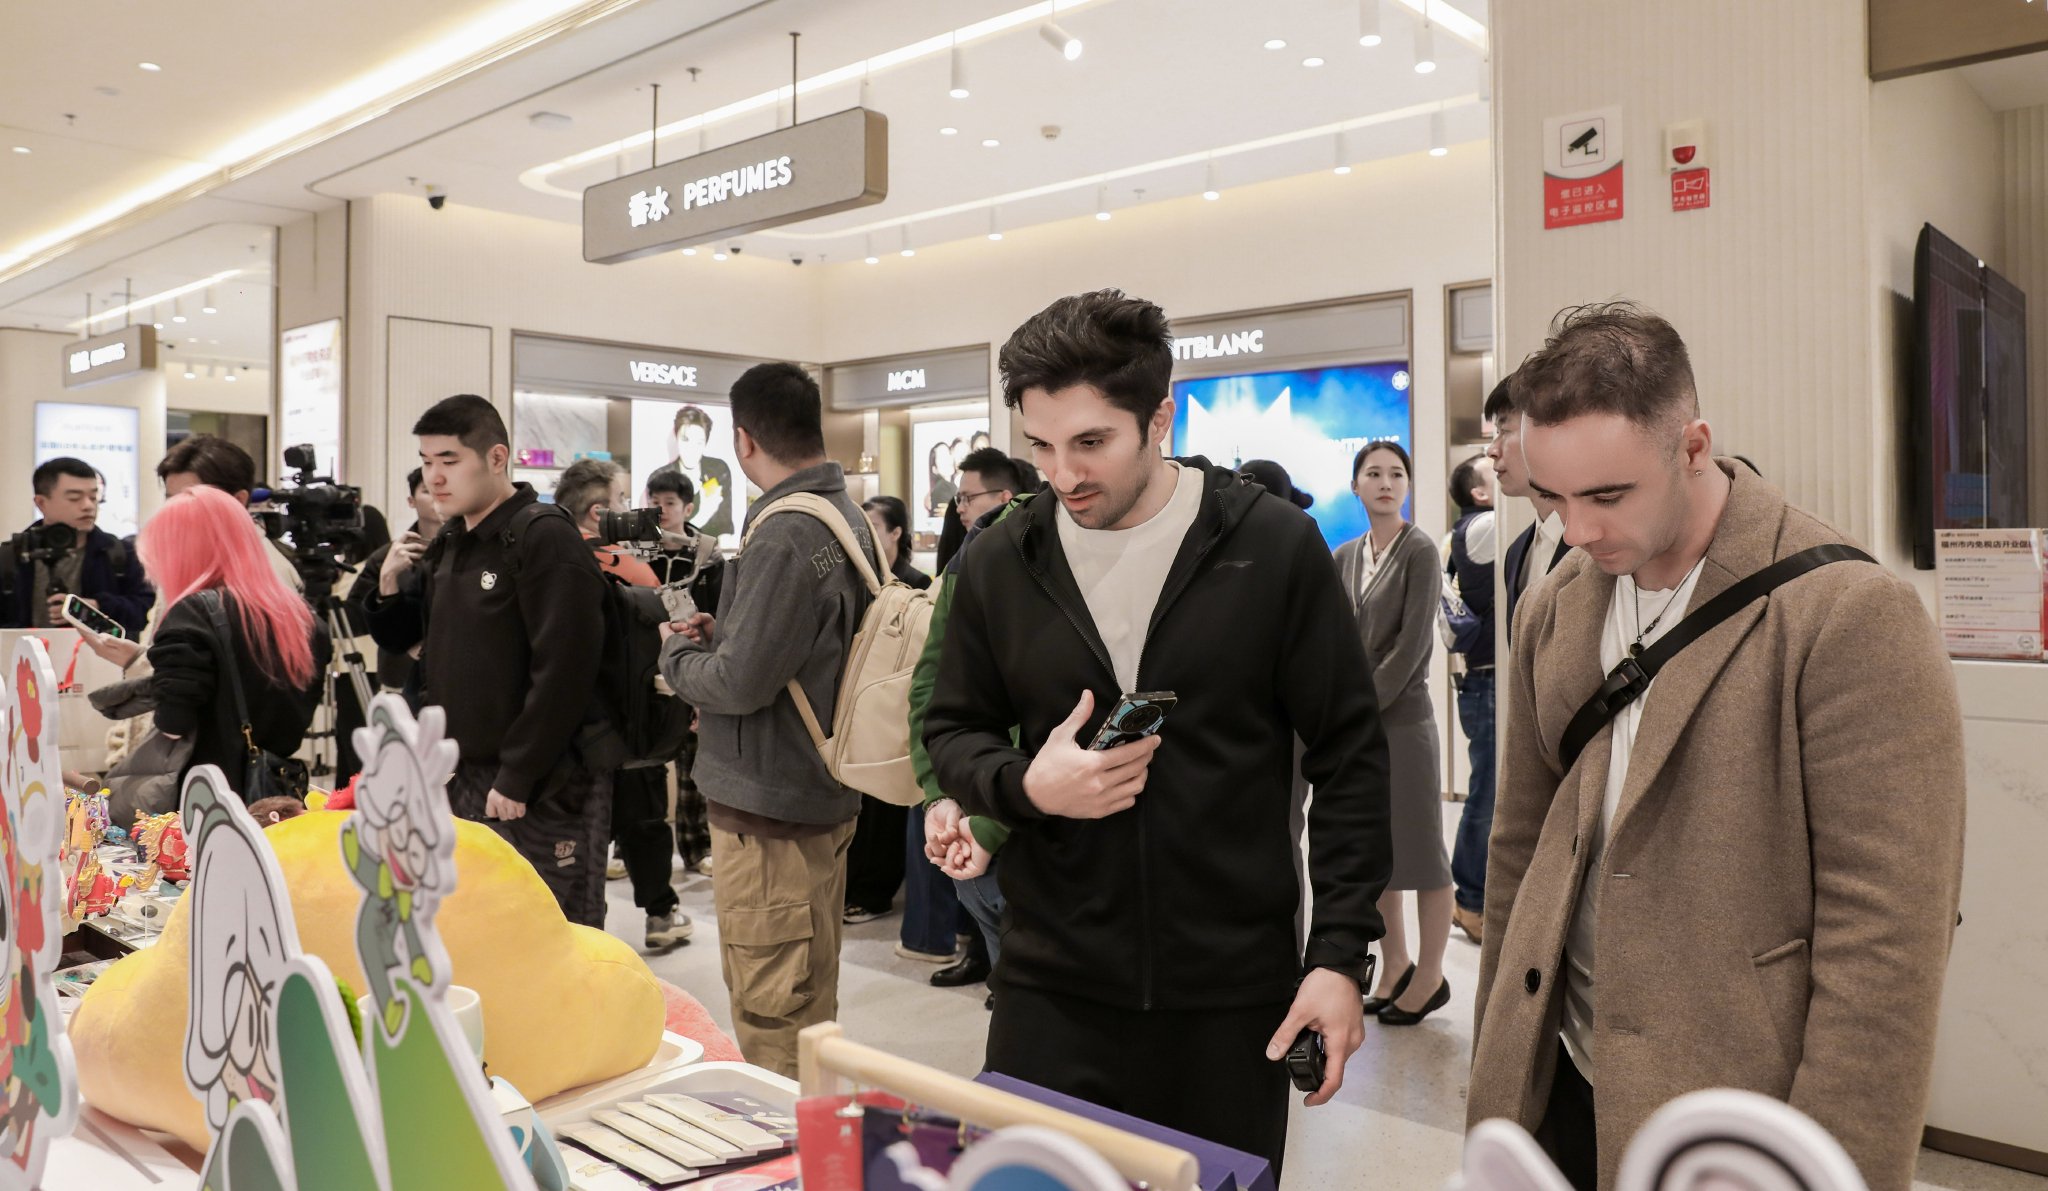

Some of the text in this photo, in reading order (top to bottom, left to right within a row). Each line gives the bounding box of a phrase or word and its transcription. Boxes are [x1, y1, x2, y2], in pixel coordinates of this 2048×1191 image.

[629, 156, 792, 227] 香水 PERFUMES
[1171, 329, 1264, 360] NTBLANC
[629, 360, 698, 387] VERSACE
[887, 368, 926, 391] MCM
[1941, 540, 2033, 549] 福州市内免税店开业促
